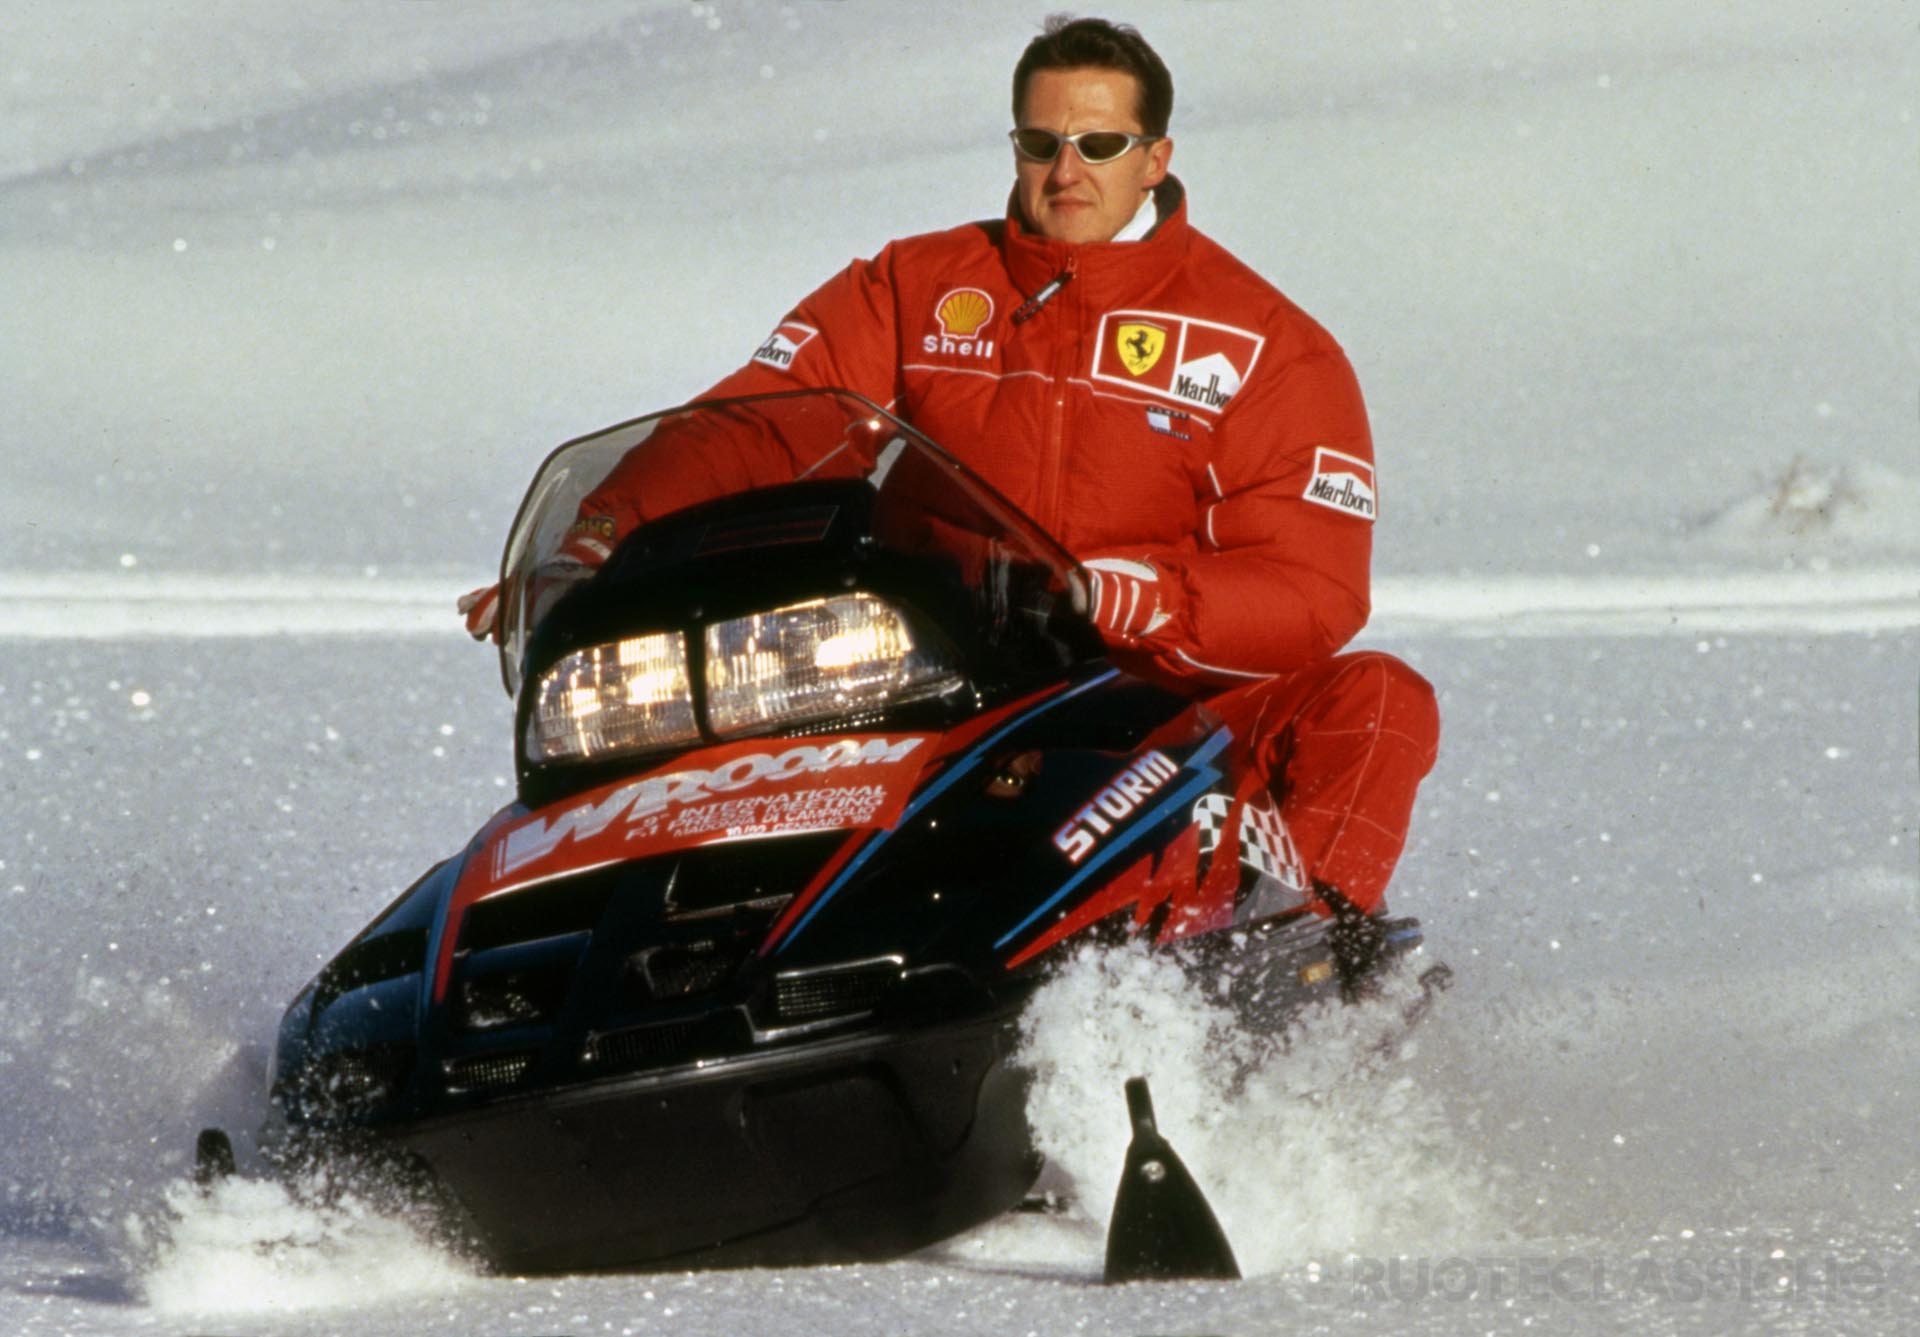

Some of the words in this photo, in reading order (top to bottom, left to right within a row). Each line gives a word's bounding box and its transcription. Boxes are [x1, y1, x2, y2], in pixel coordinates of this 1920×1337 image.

[923, 335, 993, 358] Shell
[1310, 477, 1373, 514] Marlboro
[502, 738, 925, 874] WROOOM
[667, 805, 756, 831] PRESS
[764, 795, 884, 815] MEETING
[679, 784, 888, 819] INTERNATIONAL
[785, 805, 876, 822] CAMPIGLIO
[1054, 750, 1179, 863] STORM
